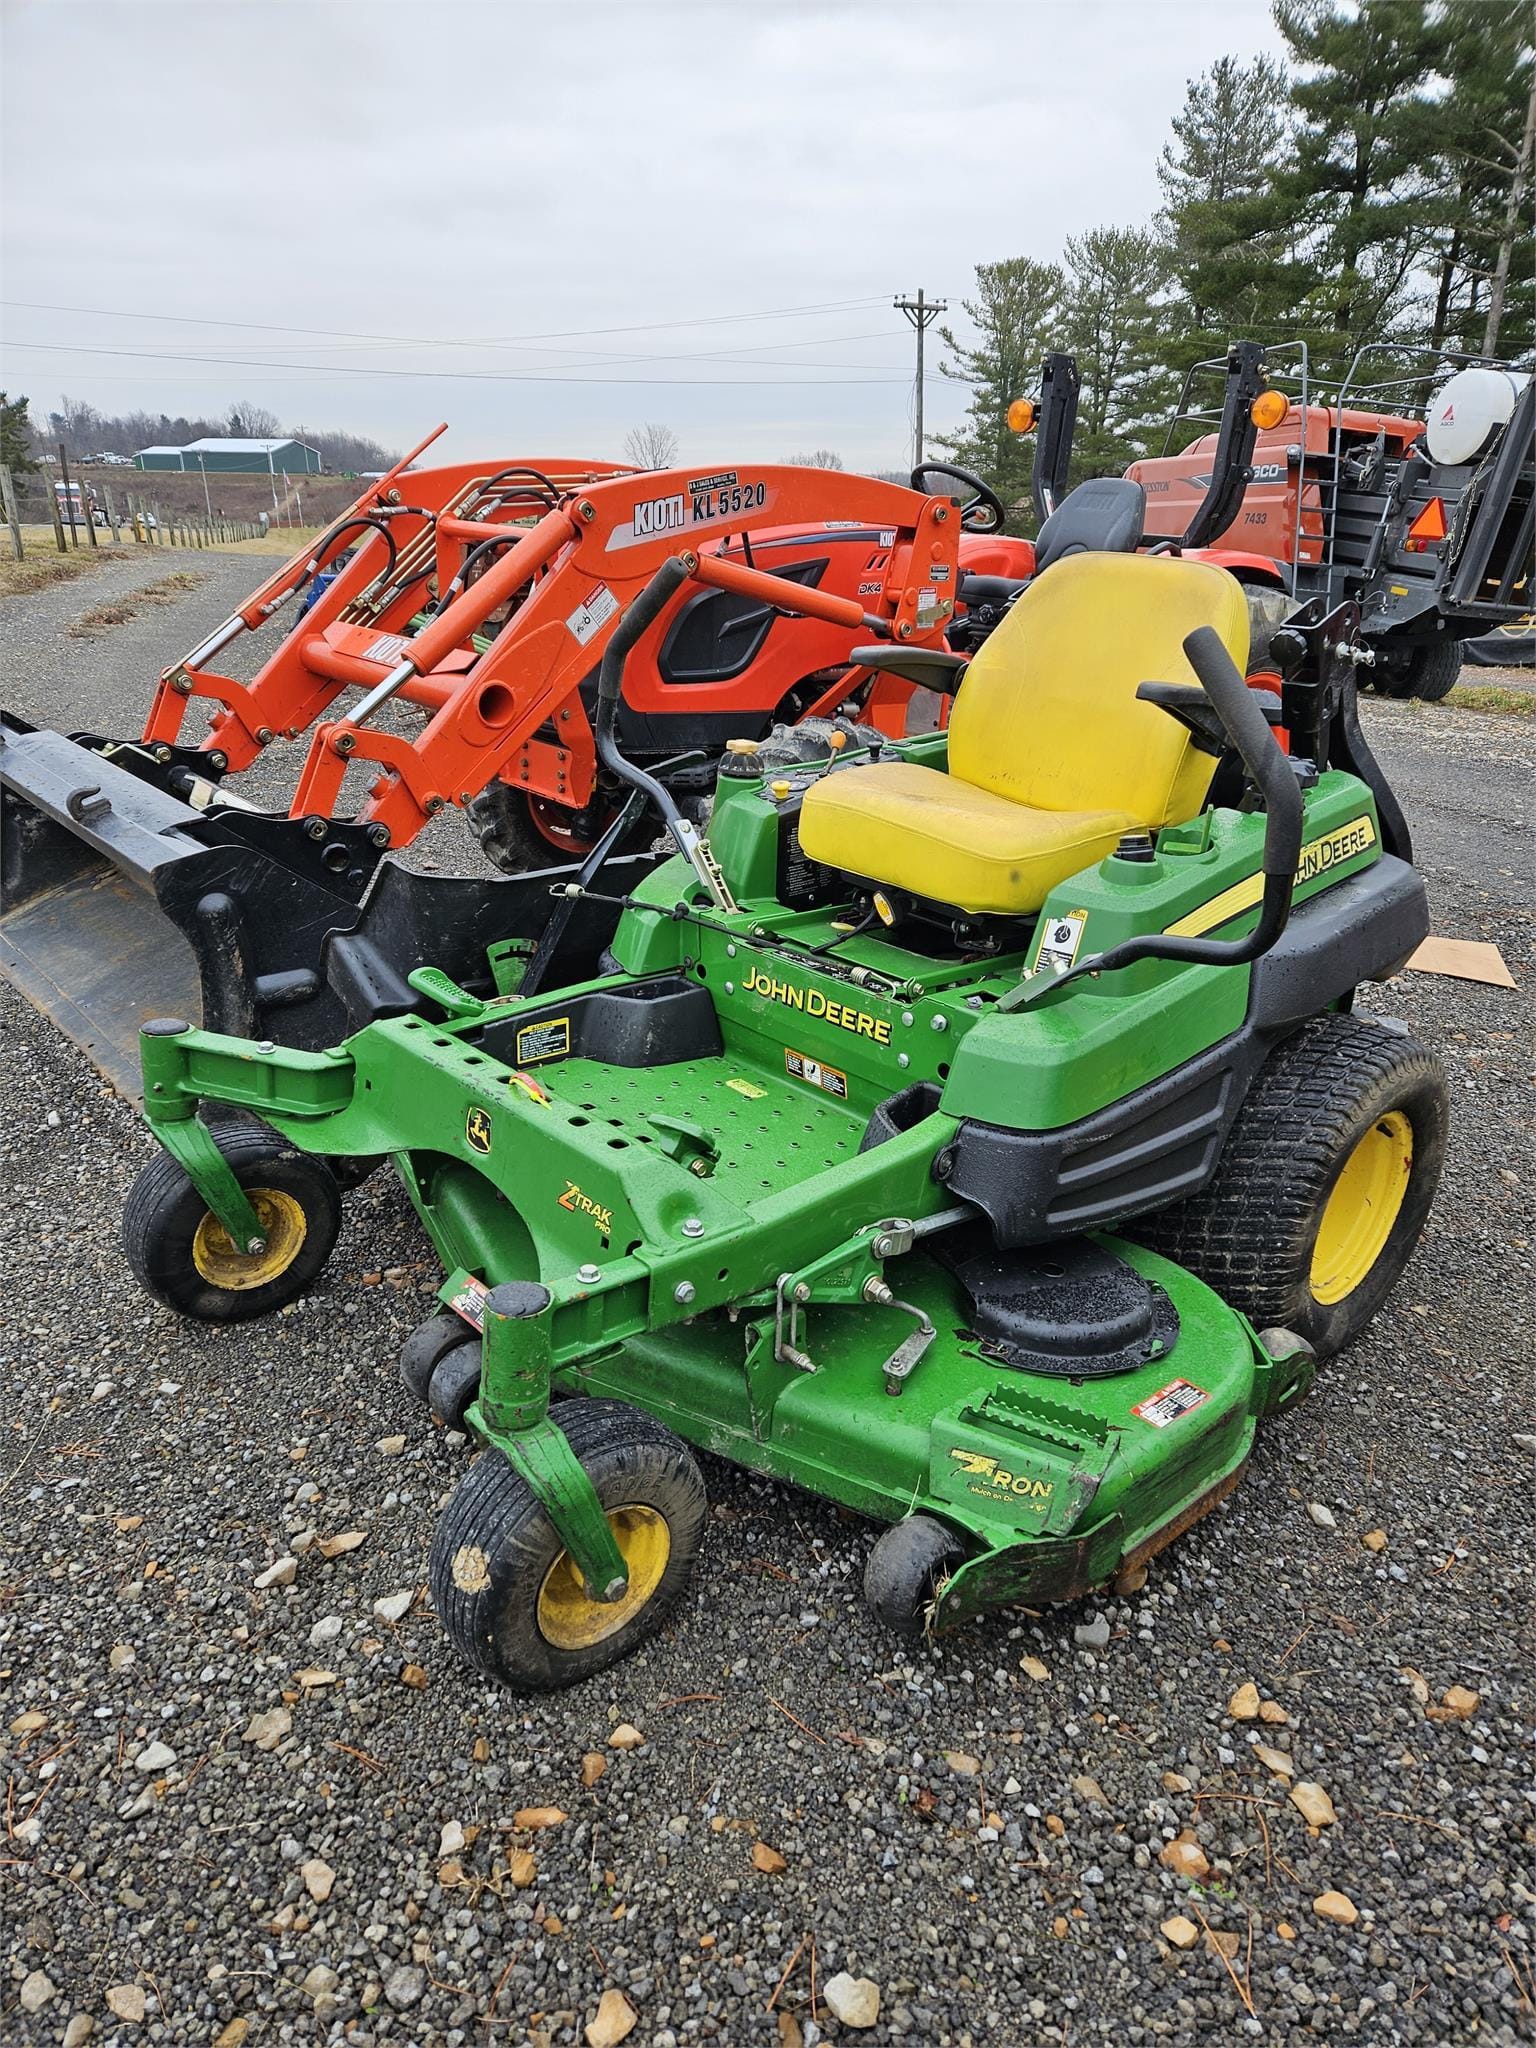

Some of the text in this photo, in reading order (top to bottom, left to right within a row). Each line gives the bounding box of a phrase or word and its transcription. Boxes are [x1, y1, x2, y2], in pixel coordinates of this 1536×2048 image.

[1252, 464, 1280, 478] GCO
[633, 493, 685, 537] KIOTI
[1244, 513, 1267, 525] 7433
[1321, 826, 1366, 869] DEERE
[742, 966, 804, 1011] JOHN
[806, 988, 892, 1046] DEERE
[595, 1220, 611, 1234] PRO
